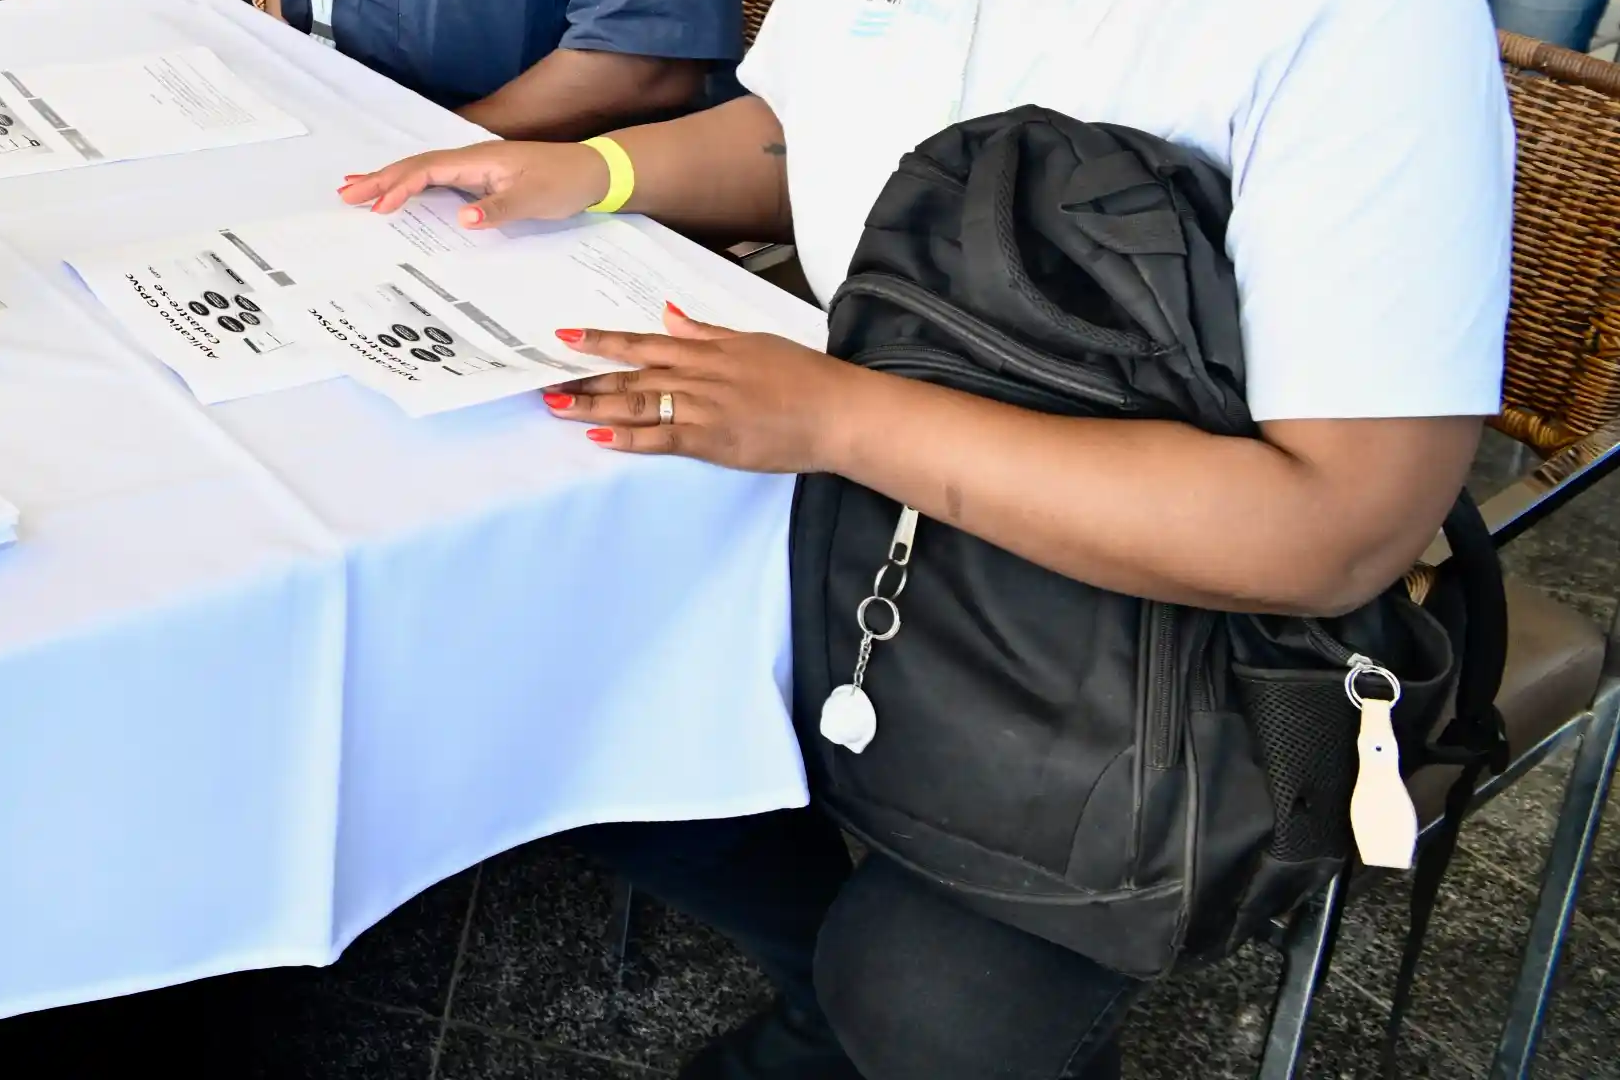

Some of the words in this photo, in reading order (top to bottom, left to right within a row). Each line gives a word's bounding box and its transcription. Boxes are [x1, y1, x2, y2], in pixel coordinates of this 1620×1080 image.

[125, 272, 160, 309] GPSvc
[153, 284, 221, 345] Cadastre-se
[159, 310, 221, 360] Aplicativo
[339, 318, 419, 372] Cadastre-se
[349, 342, 422, 382] Aplicativo
